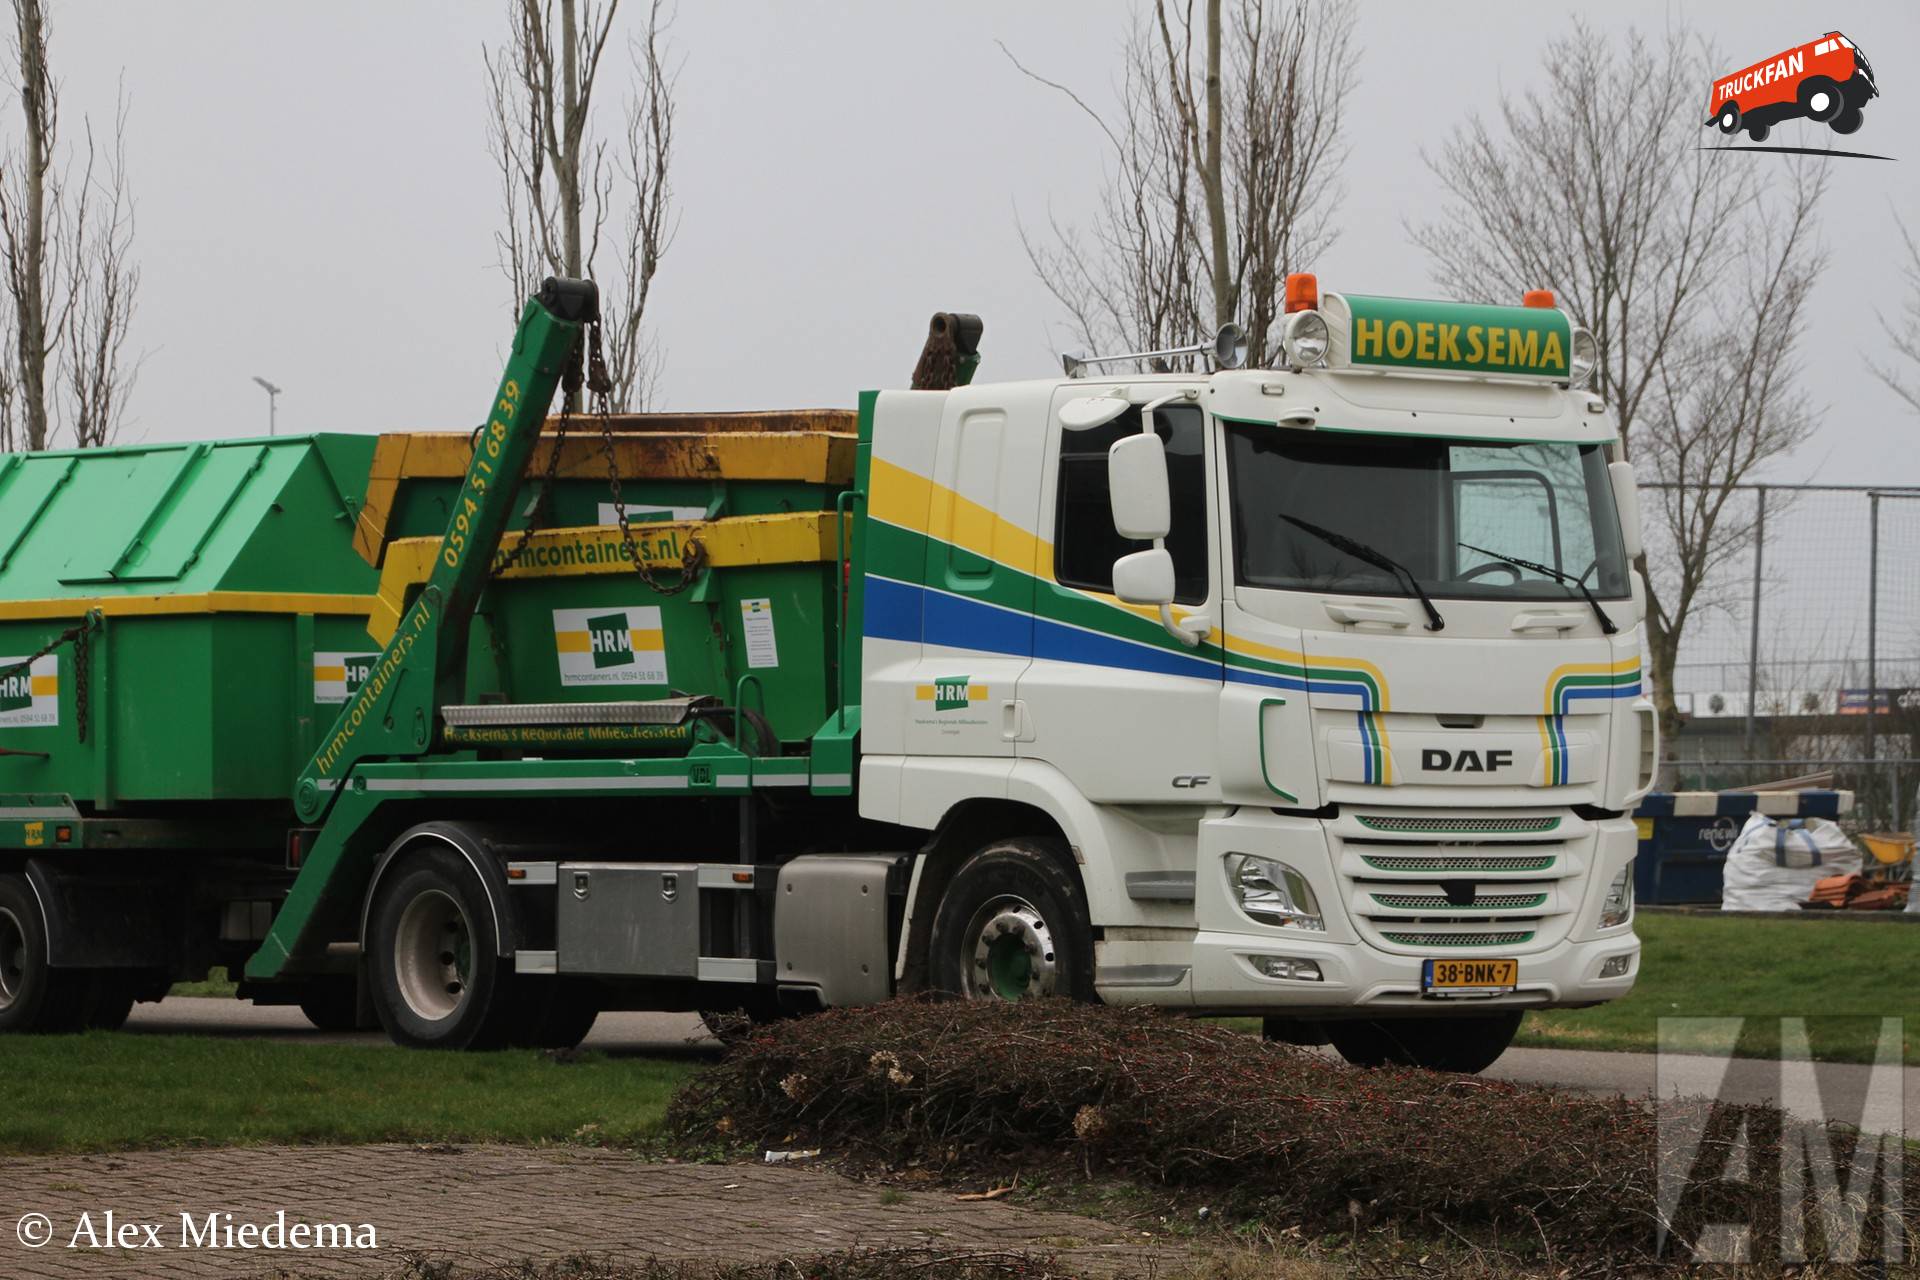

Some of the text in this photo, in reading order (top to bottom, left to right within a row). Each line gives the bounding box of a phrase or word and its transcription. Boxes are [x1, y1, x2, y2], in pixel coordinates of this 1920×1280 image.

[1356, 318, 1565, 369] HOEKSEMA
[444, 497, 478, 568] 0594
[486, 419, 506, 459] 68
[499, 379, 520, 420] 39
[496, 531, 680, 568] hmcontaines.nl
[589, 629, 633, 653] HRM
[344, 665, 371, 682] HR
[315, 600, 431, 776] hrmcontainers.nl
[934, 685, 969, 701] HRM
[1421, 749, 1513, 772] DAF
[1171, 776, 1212, 789] CF
[1436, 963, 1512, 984] 38-BNK-7
